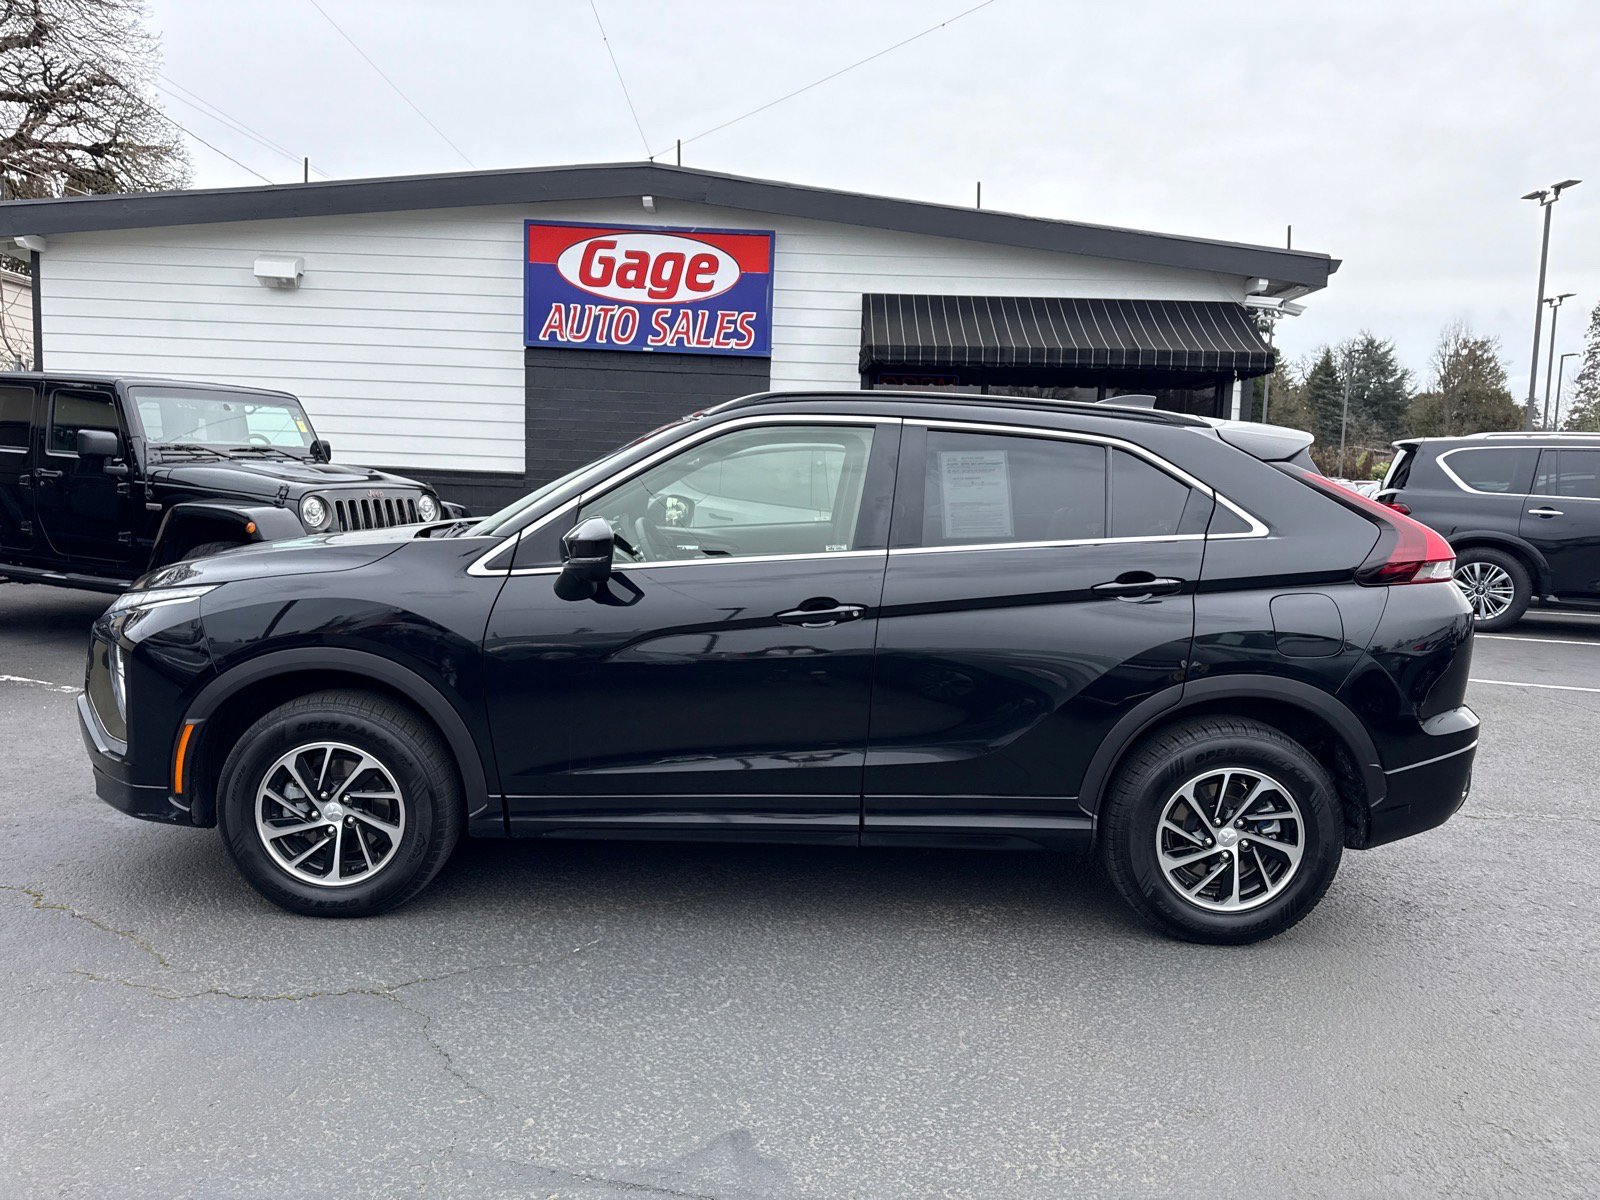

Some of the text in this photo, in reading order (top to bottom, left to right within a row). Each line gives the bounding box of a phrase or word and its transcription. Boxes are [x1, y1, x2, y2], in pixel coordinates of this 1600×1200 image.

[579, 240, 719, 299] Gage
[539, 303, 756, 350] AUTO SALES
